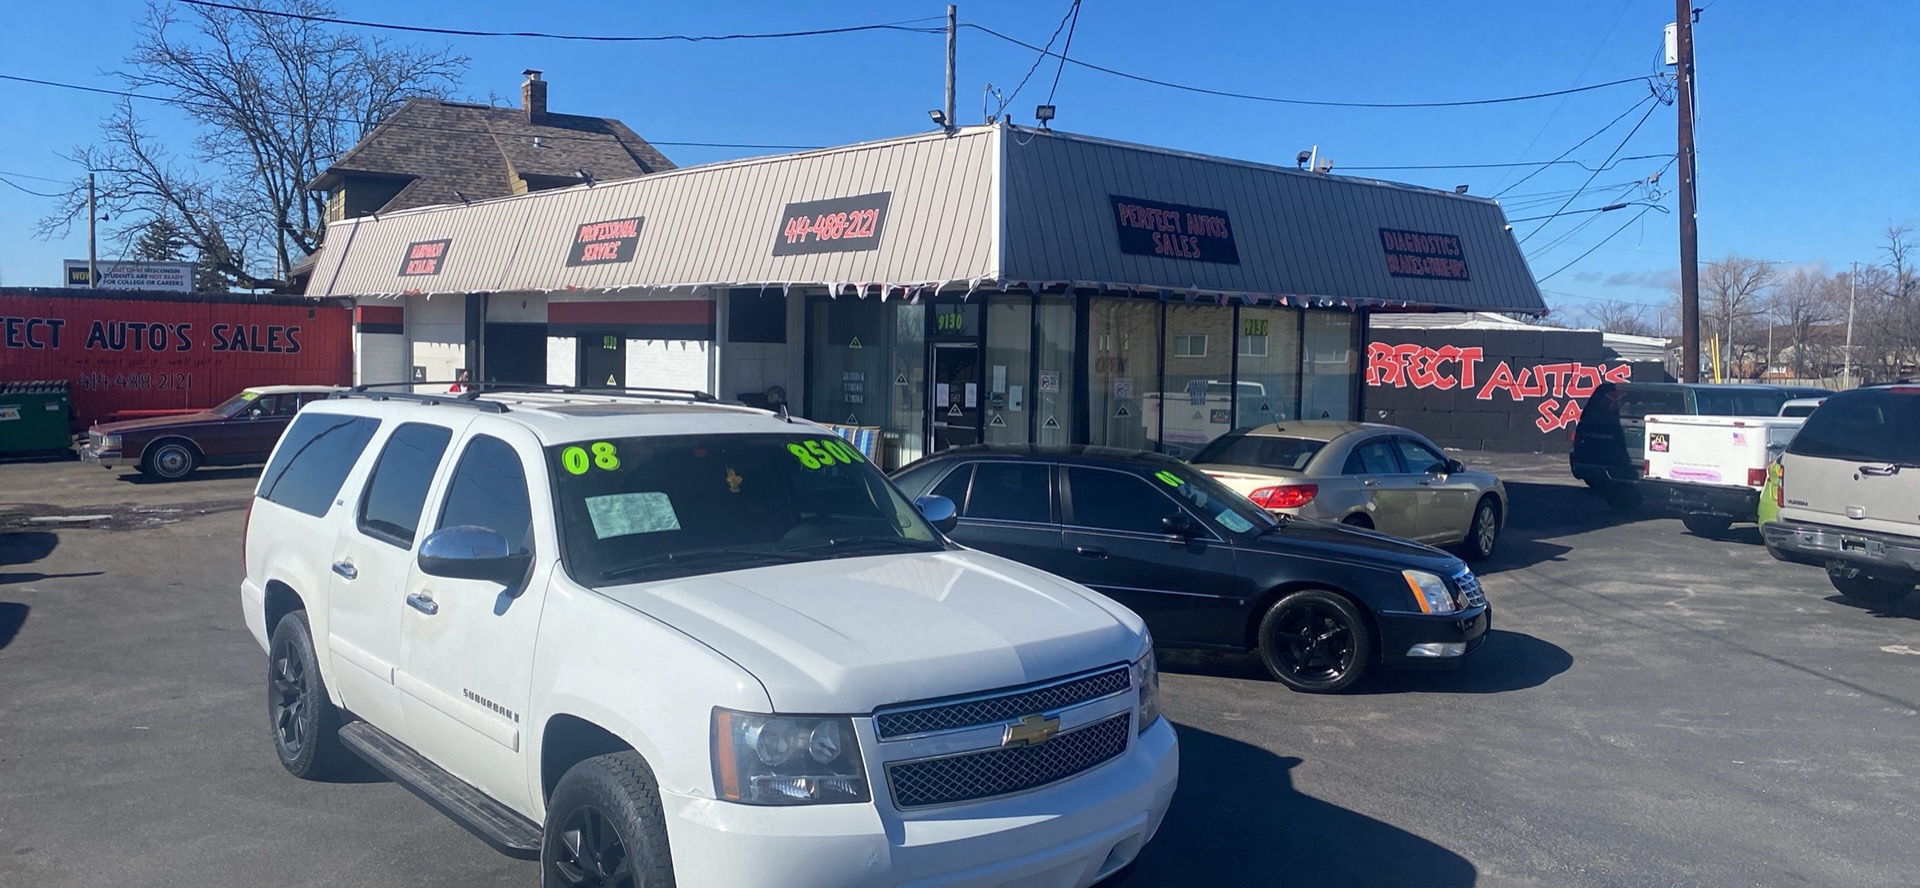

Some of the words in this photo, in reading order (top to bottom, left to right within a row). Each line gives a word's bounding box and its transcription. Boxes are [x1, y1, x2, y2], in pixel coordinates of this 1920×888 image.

[578, 219, 639, 243] PROFESSIONAL
[784, 208, 879, 244] 414-488-2121
[1118, 203, 1182, 233] PERFECT
[1186, 213, 1228, 239] AUTO'S
[581, 241, 621, 261] SERVICE
[1152, 231, 1200, 259] SALES
[1383, 231, 1460, 256] DIAGNOSTICS
[0, 316, 66, 350] ECT
[85, 319, 192, 353] AUTO'S
[212, 323, 301, 354] SALES
[939, 313, 962, 330] 9130
[1245, 319, 1268, 336] 9130
[77, 371, 193, 391] 414-488-2121
[1366, 341, 1483, 391] RFECT
[1476, 360, 1632, 400] AUTO'S
[562, 436, 621, 475] 08
[787, 439, 865, 469] 8500
[463, 688, 513, 720] SUBURBAN
